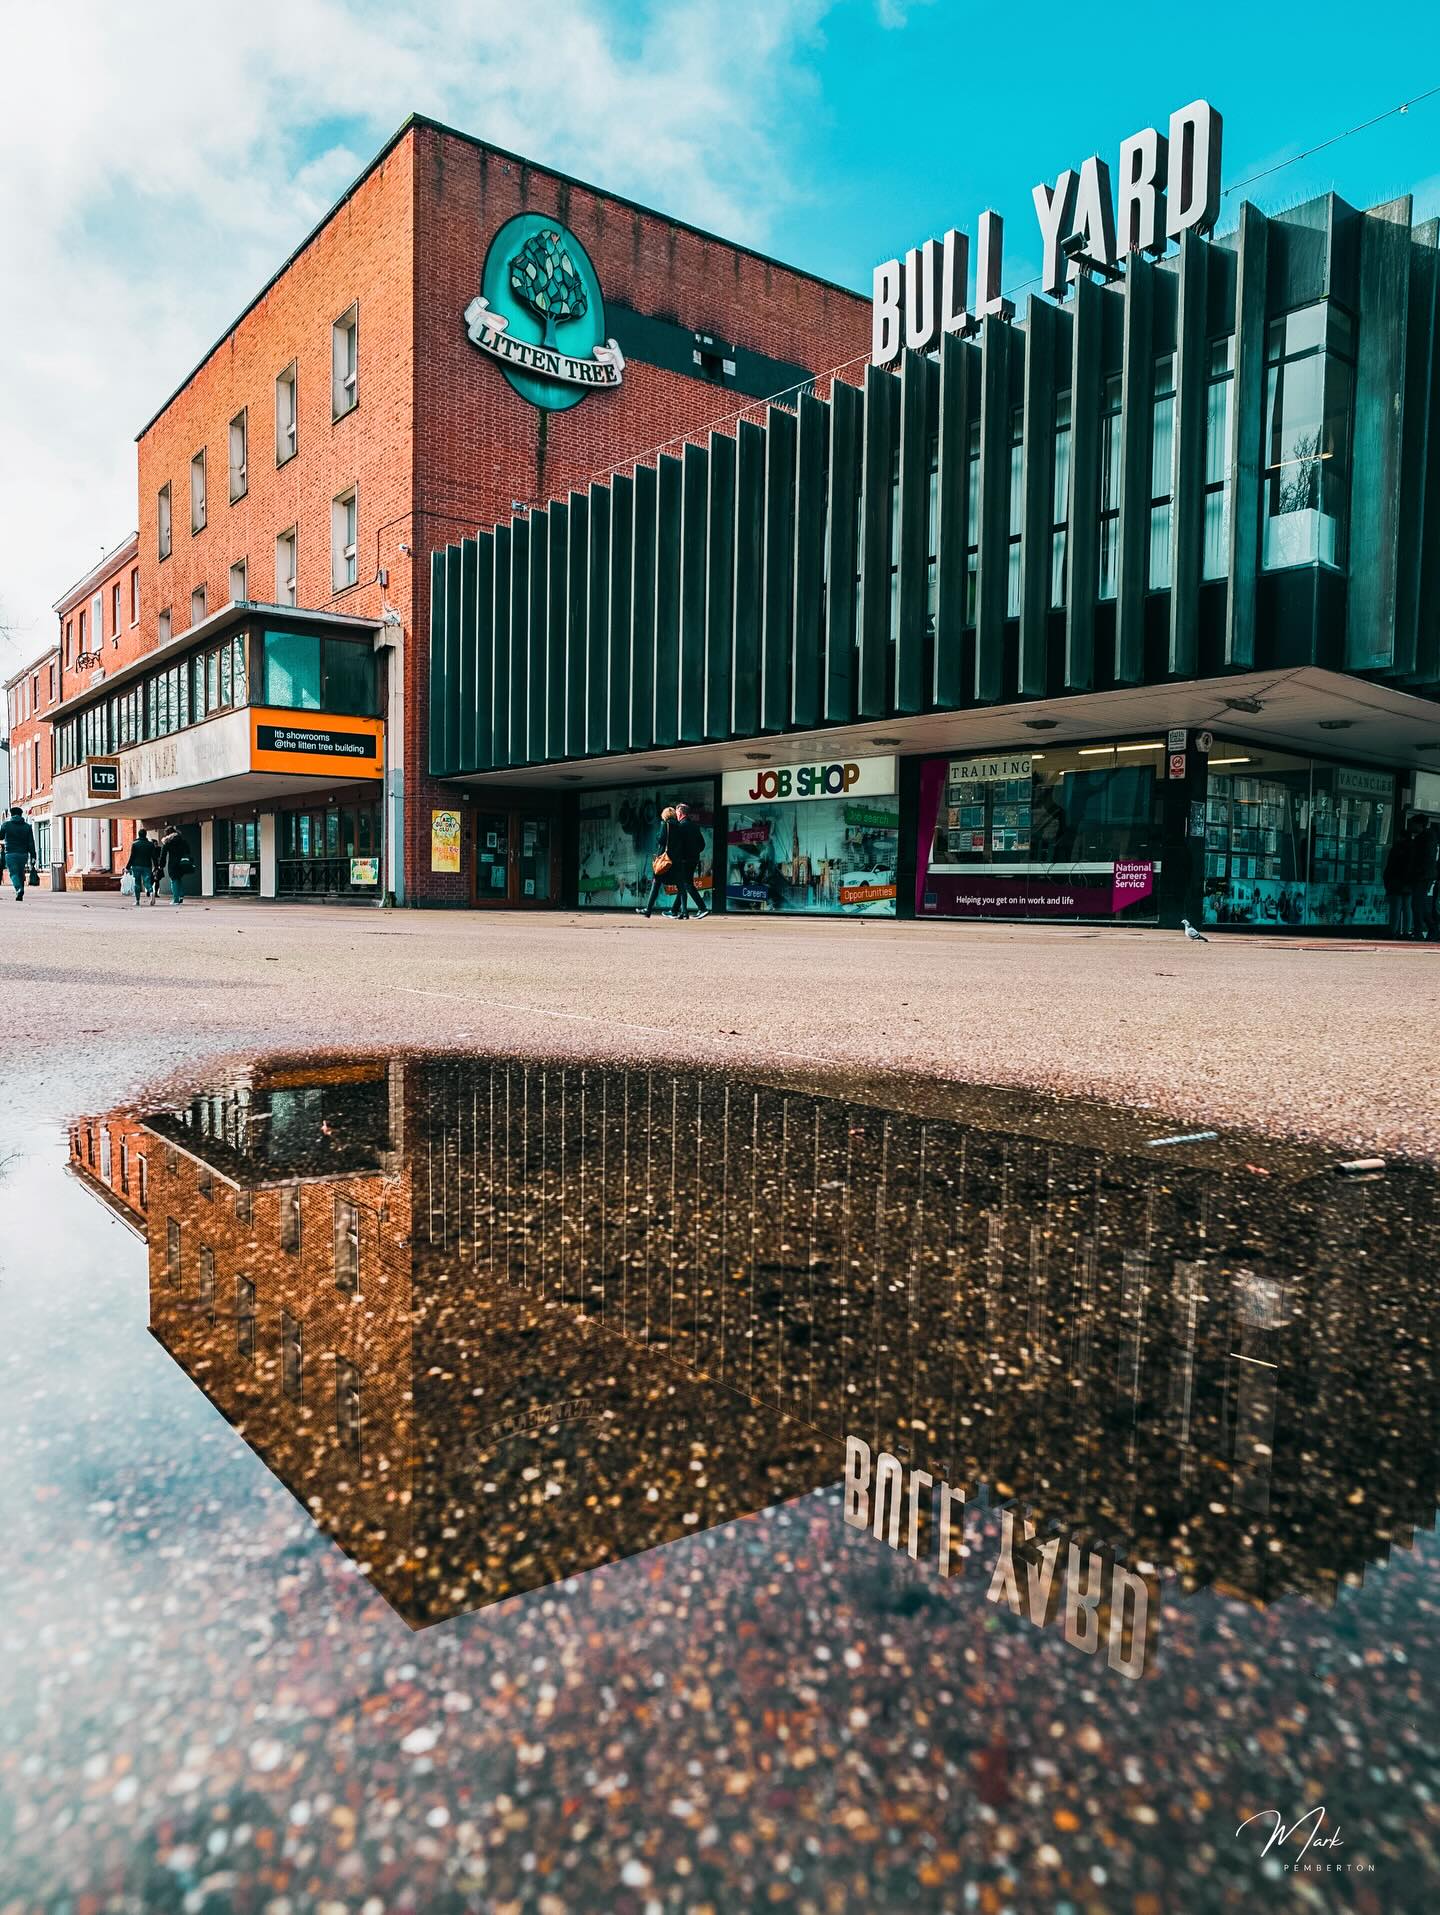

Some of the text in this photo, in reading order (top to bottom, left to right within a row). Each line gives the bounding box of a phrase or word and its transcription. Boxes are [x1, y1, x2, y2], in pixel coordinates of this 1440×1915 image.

[872, 98, 1223, 367] BULL YARD
[476, 323, 618, 384] LITTEN TREE
[274, 730, 330, 742] ltb showrooms
[274, 739, 365, 755] @the litten tree building
[951, 760, 1031, 779] TRAINING
[94, 772, 115, 784] LTB
[748, 763, 860, 801] JOB SHOP
[863, 814, 889, 825] search
[1115, 863, 1152, 872] National
[1115, 872, 1147, 880] Careers
[1115, 880, 1145, 888] Service
[742, 887, 767, 899] Careers
[843, 886, 893, 902] Opportunities
[956, 895, 981, 906] Helping
[982, 897, 995, 906] you
[996, 897, 1007, 905] get
[1019, 896, 1026, 904] in
[1027, 896, 1045, 904] work
[1046, 896, 1061, 904] and
[1061, 896, 1074, 905] life
